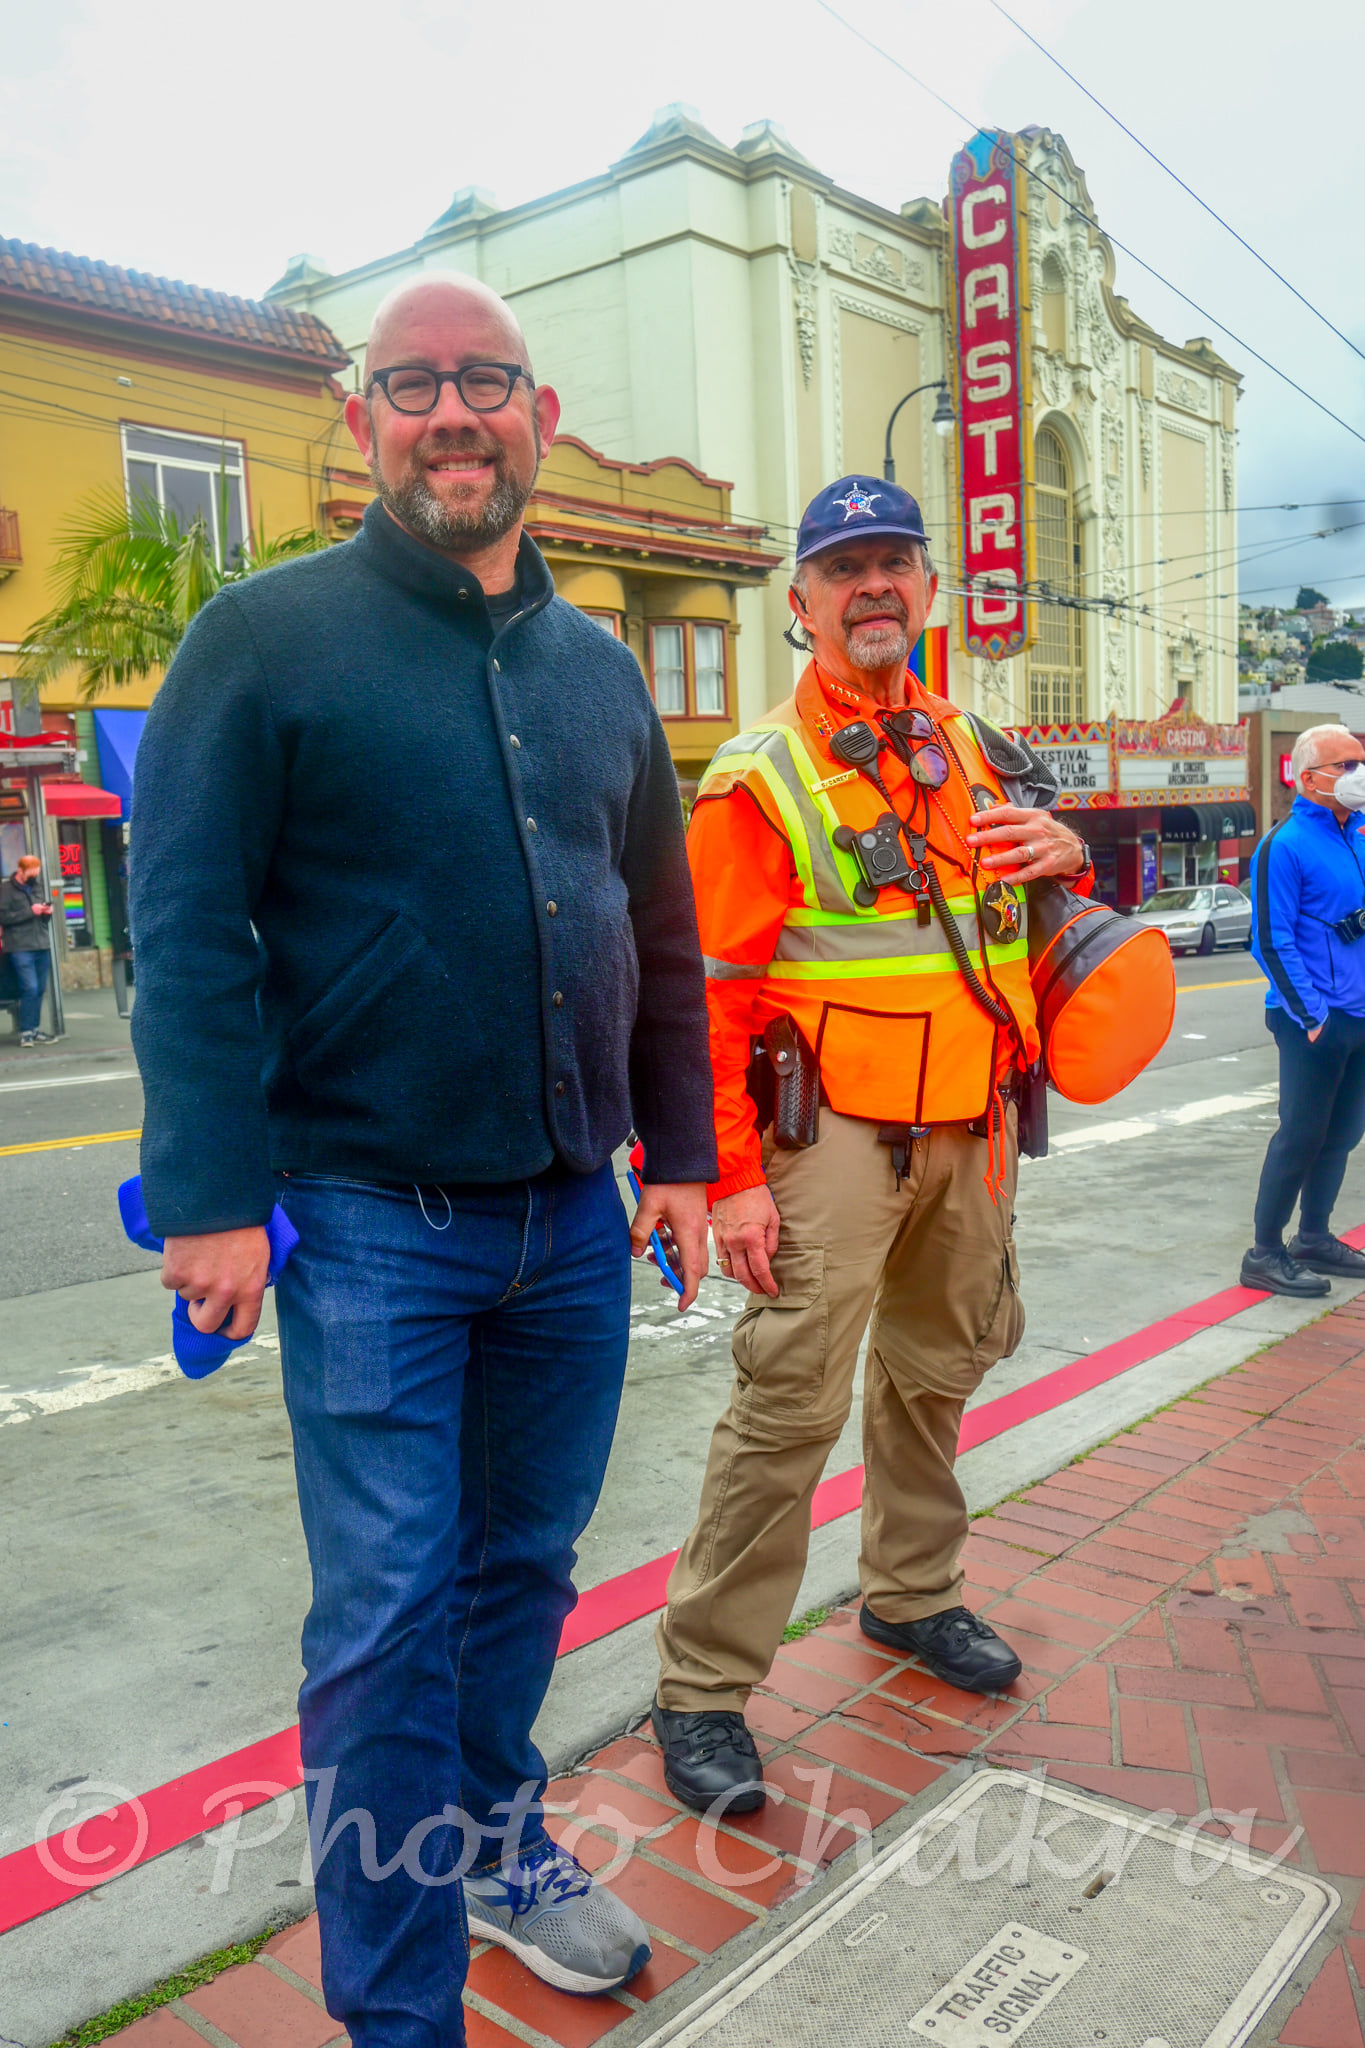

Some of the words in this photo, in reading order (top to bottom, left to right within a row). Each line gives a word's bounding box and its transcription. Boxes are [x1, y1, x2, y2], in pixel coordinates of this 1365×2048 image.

[961, 183, 1018, 627] CASTRO
[1167, 729, 1206, 747] CASTRO
[1060, 763, 1088, 774] FILM
[1061, 776, 1096, 788] M.ORG
[1165, 831, 1197, 839] NAILS
[59, 844, 81, 863] OT
[935, 1944, 1026, 2020] TRAFFIC
[983, 1969, 1061, 2034] SIGNAL
